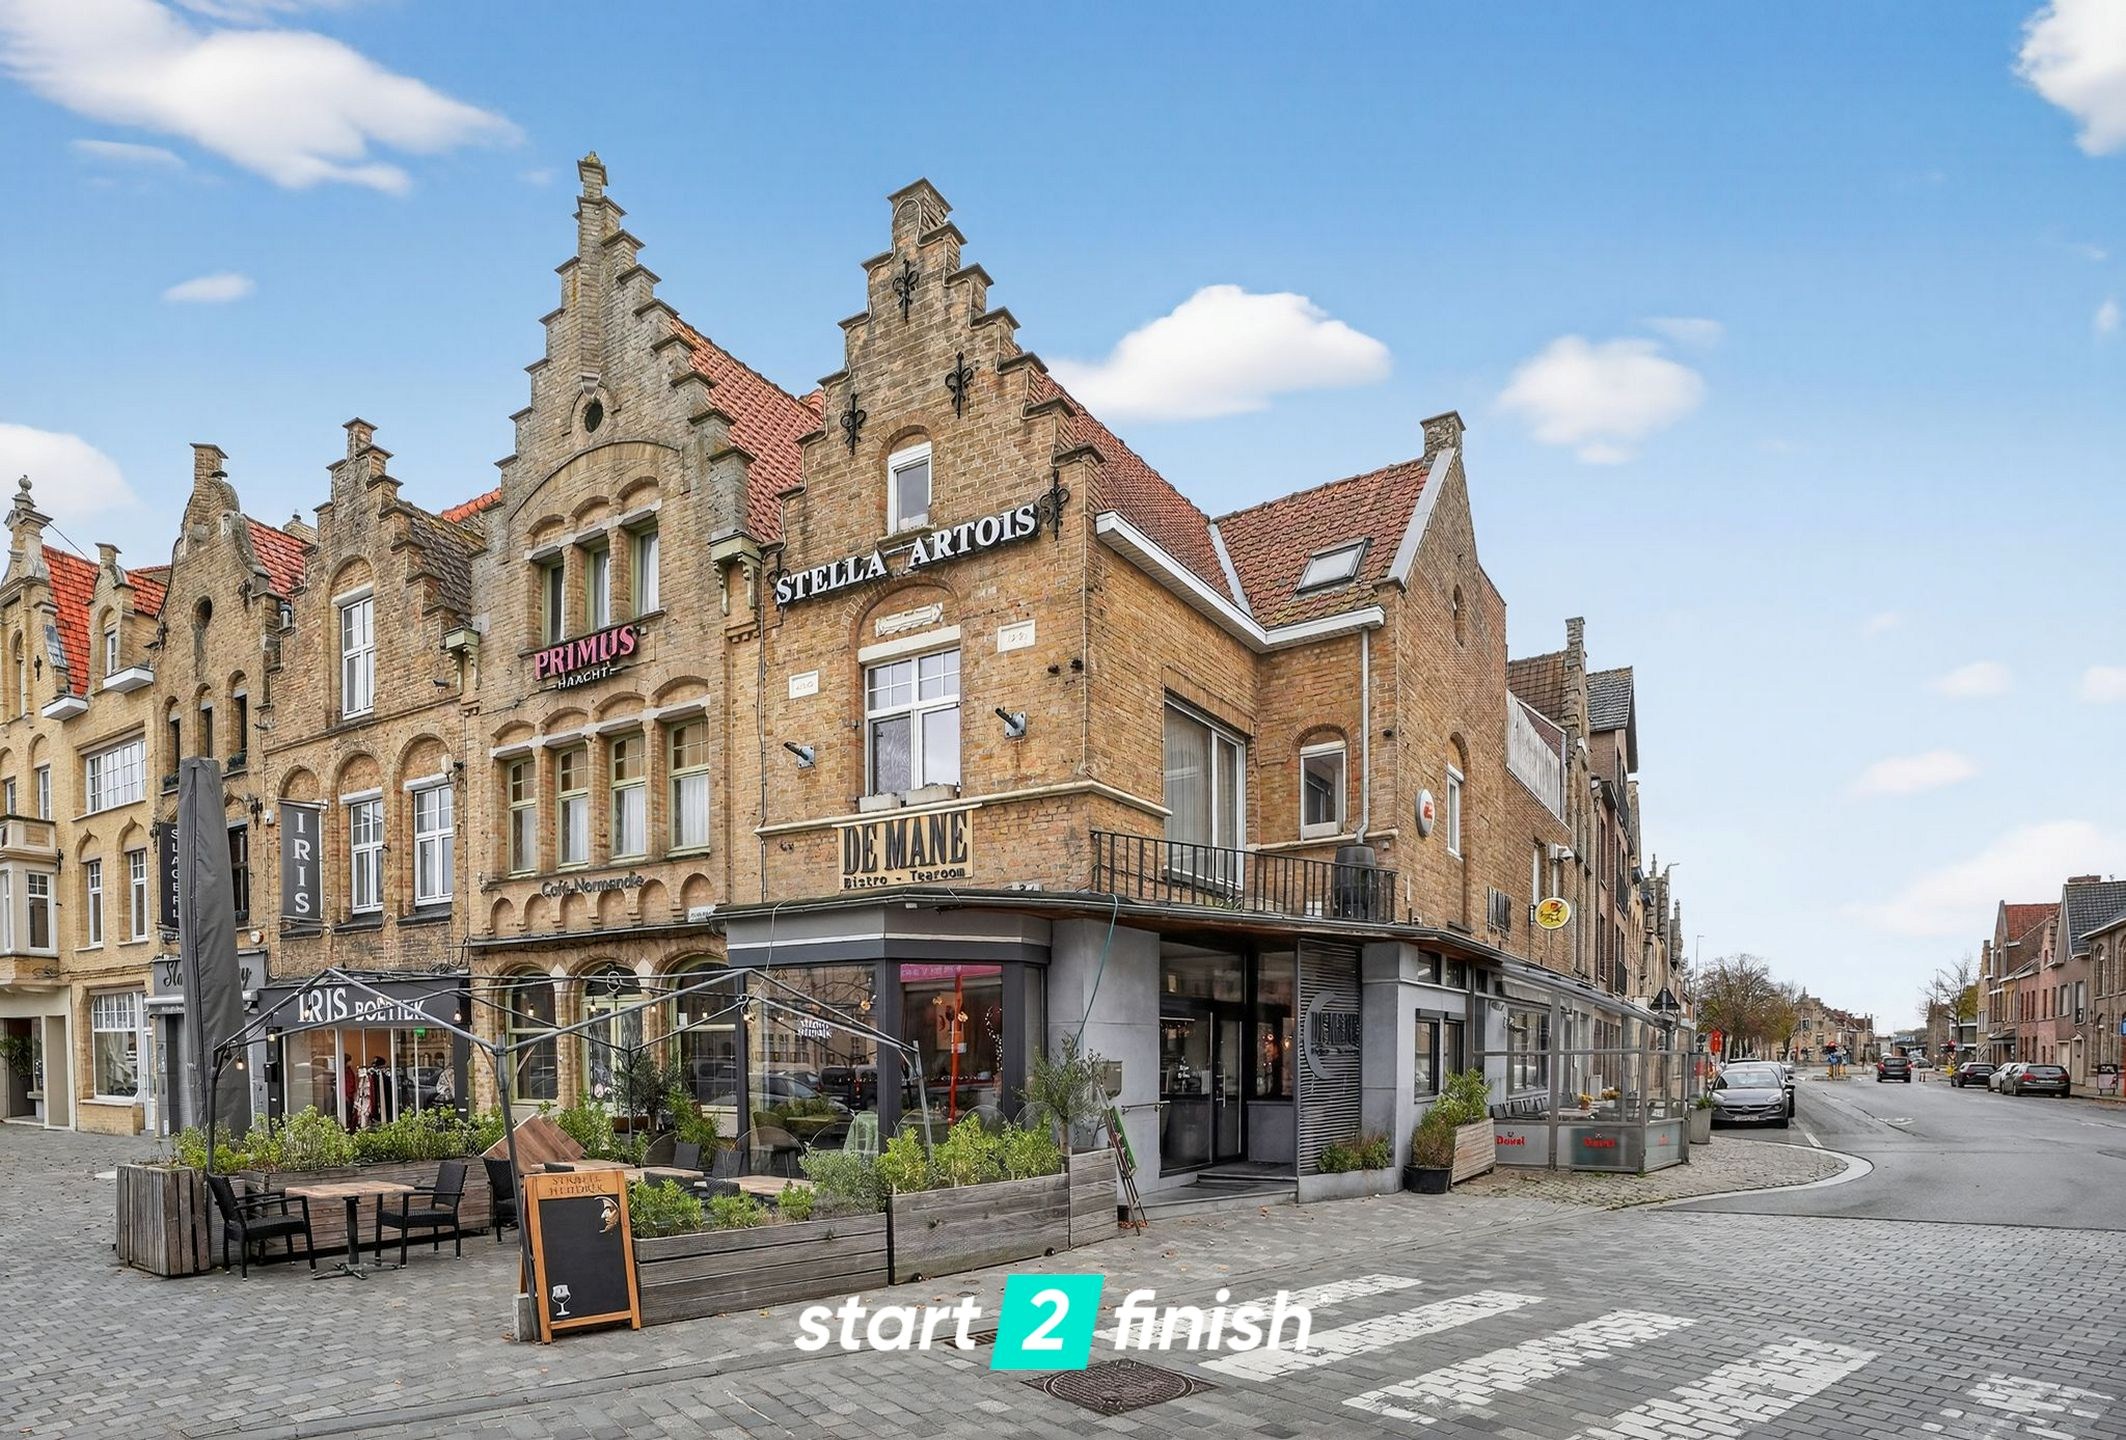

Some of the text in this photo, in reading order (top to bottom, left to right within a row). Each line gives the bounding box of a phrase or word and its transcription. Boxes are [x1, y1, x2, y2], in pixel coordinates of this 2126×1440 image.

[776, 503, 1036, 604] STELLA ARTOIS
[534, 624, 636, 680] PRIMUS
[558, 666, 610, 689] HAACHT
[291, 811, 312, 914] IRIS
[843, 809, 968, 876] DE MANE
[843, 875, 888, 889] Bistro
[910, 867, 966, 882] Tearoom
[298, 987, 348, 1023] IRIS
